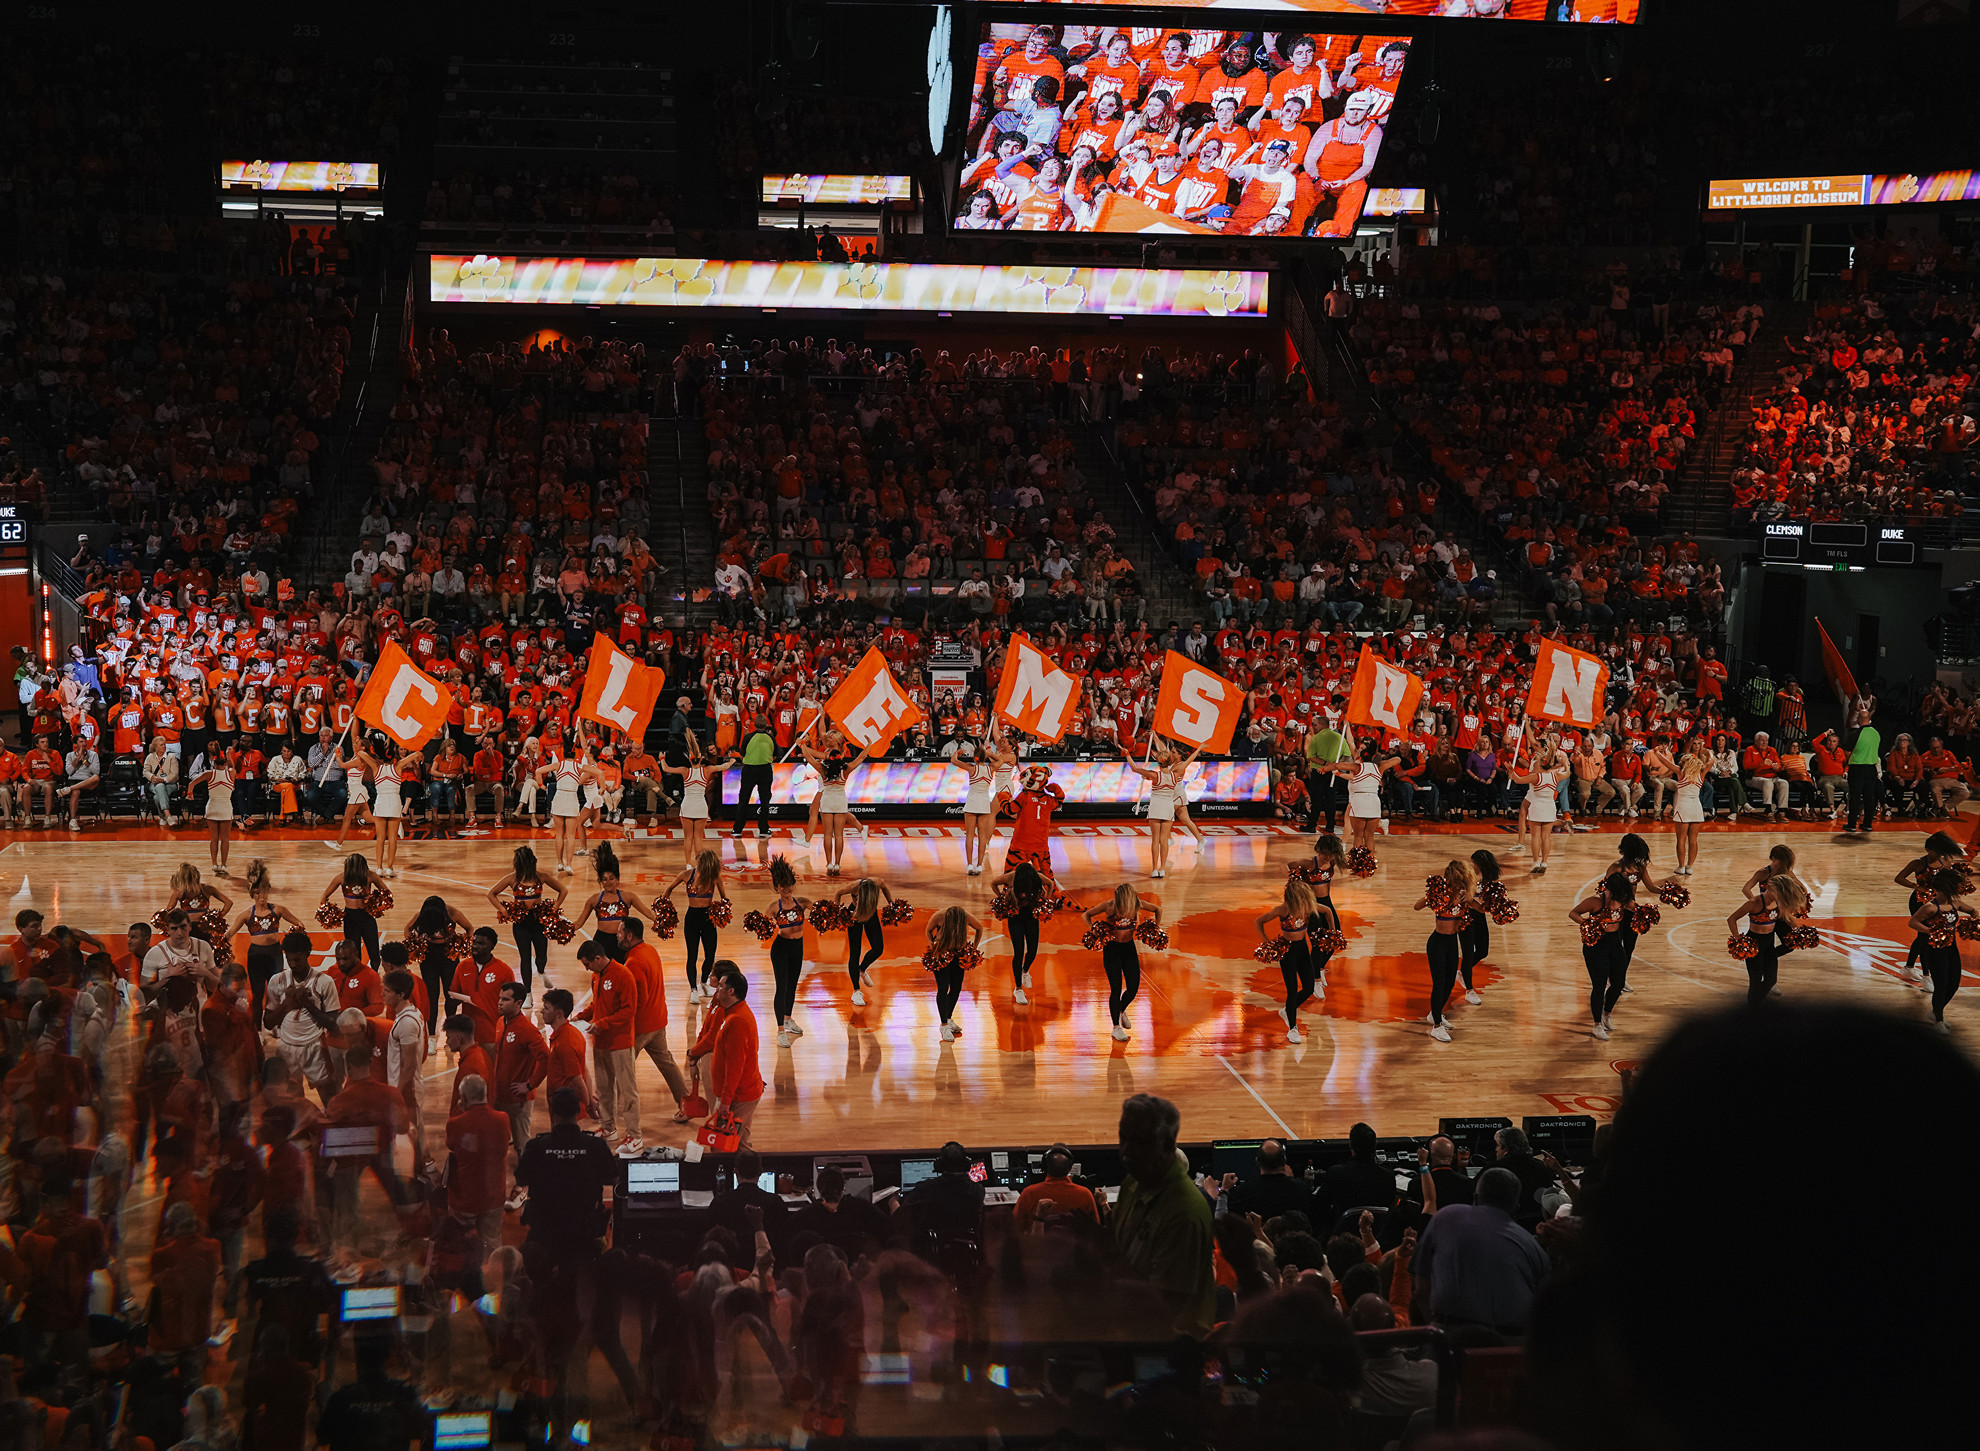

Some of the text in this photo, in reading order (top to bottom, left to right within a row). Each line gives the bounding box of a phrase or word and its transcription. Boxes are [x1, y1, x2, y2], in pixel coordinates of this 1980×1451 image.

[28, 5, 57, 20] 234
[293, 24, 320, 37] 233
[549, 33, 575, 45] 232
[1805, 43, 1834, 57] 227
[1545, 57, 1573, 69] 228
[1743, 180, 1831, 193] WELCOME TO
[1712, 192, 1859, 207] LITTLEJOHN COLISEUM
[1034, 213, 1049, 231] 2
[0, 507, 16, 517] UKE
[1, 523, 21, 540] 62
[1766, 525, 1803, 536] CLEMSON
[1881, 529, 1905, 540] DUKE
[1835, 562, 1848, 572] EXIT
[596, 650, 638, 732] L
[1005, 643, 1074, 738] M
[1543, 648, 1601, 723] N
[381, 663, 439, 740] C
[842, 667, 909, 746] E
[1171, 668, 1225, 743] S
[185, 701, 200, 723] C
[248, 709, 258, 727] E
[273, 708, 288, 729] M
[304, 707, 317, 729] S
[469, 705, 484, 729] I
[1119, 711, 1128, 721] 24
[121, 712, 141, 729] GRIT
[921, 722, 928, 731] 2
[975, 724, 983, 735] 2
[1036, 804, 1041, 820] 1
[707, 1134, 717, 1145] G
